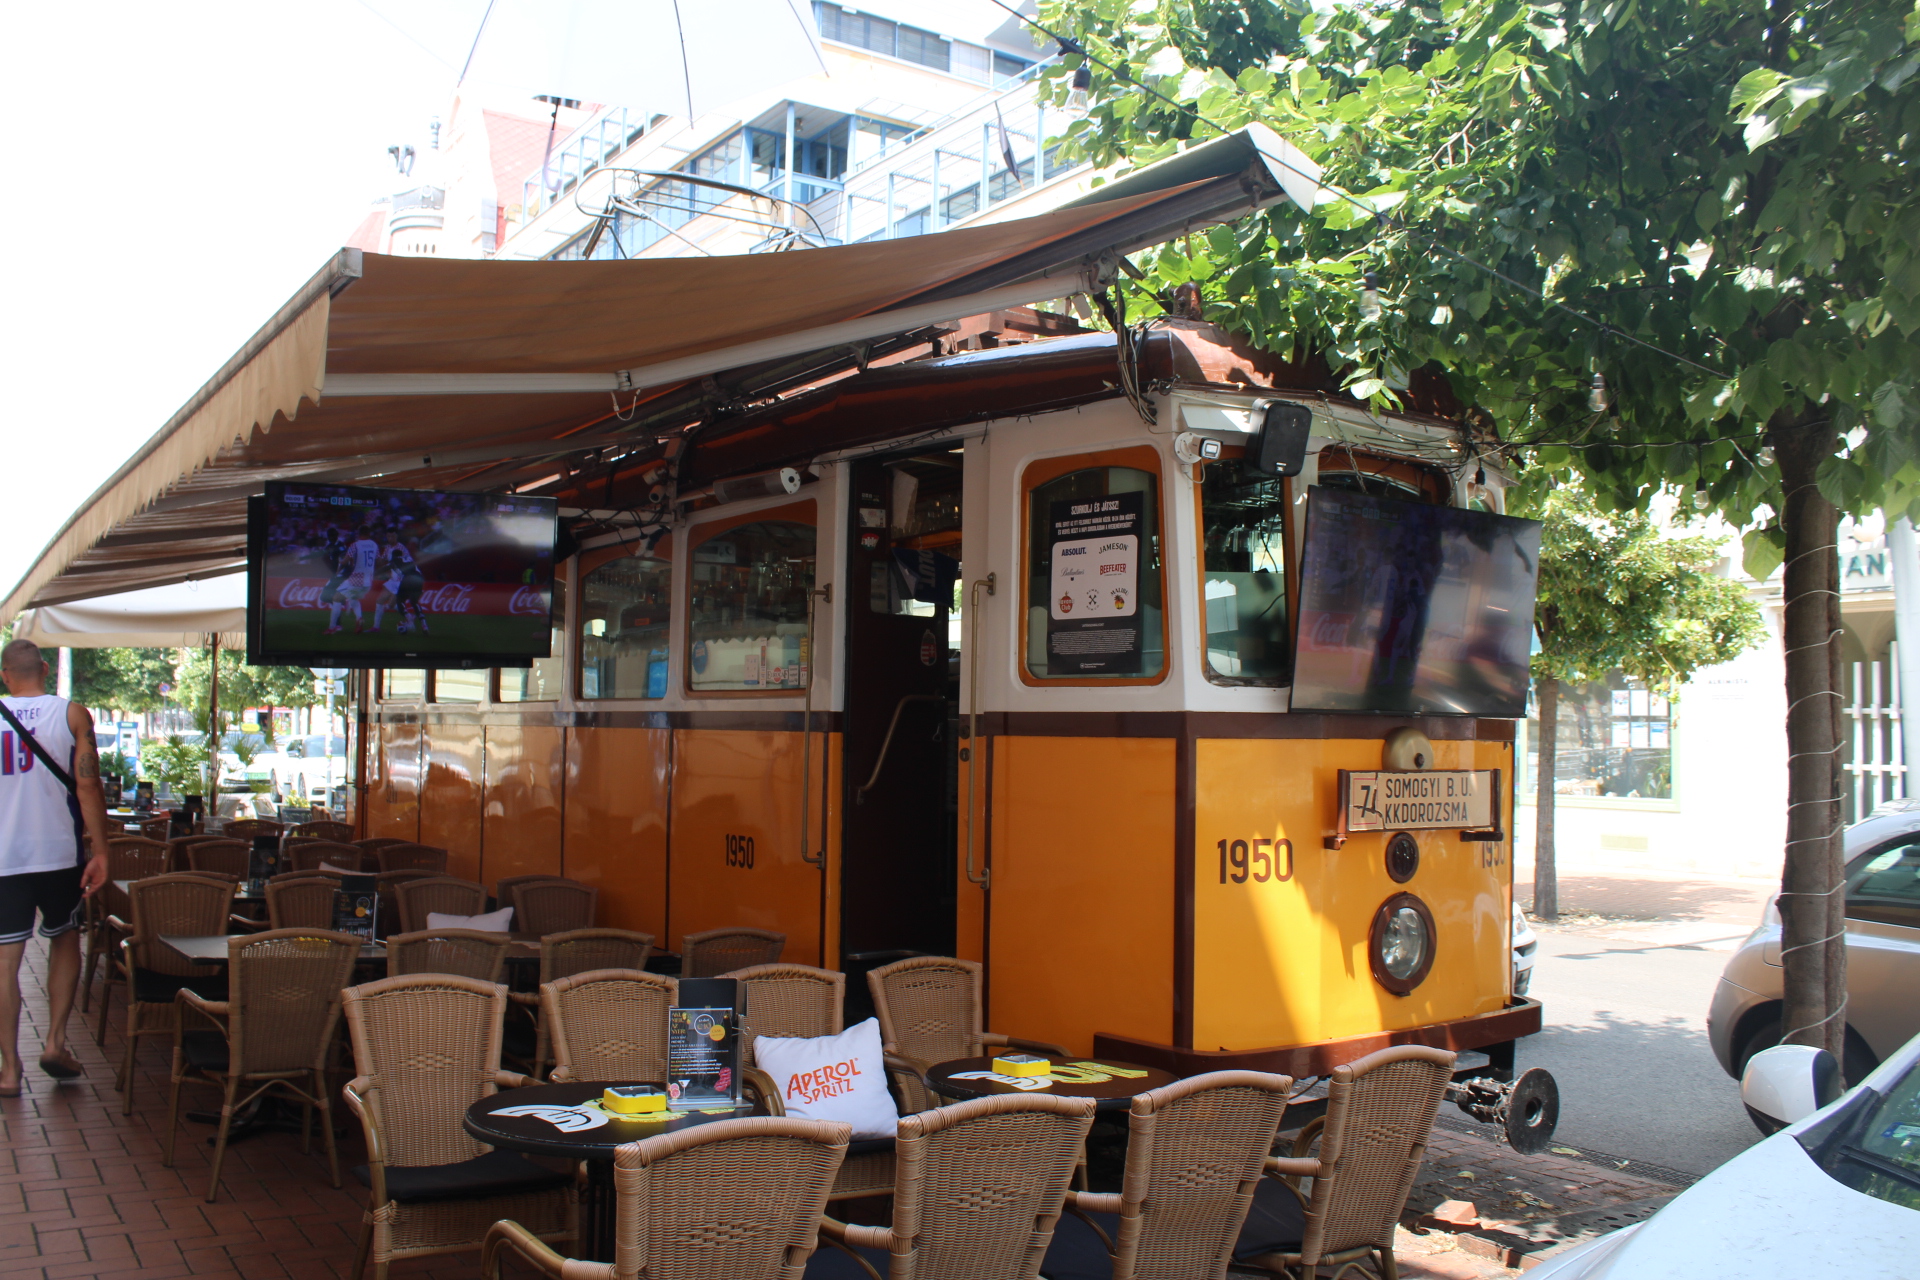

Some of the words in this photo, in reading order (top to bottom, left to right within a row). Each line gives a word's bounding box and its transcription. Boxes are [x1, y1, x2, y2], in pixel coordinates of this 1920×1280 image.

[1098, 542, 1128, 554] JAMESON
[1099, 563, 1127, 575] BEEFEATER
[1839, 553, 1884, 577] AN
[1385, 778, 1440, 798] SOMOGYI
[1447, 778, 1458, 797] B.
[1461, 777, 1472, 796] U.
[1385, 802, 1468, 824] KKDOROZSMA
[725, 833, 754, 869] 1950
[1217, 838, 1293, 884] 1950
[1482, 841, 1505, 869] 1950
[787, 1059, 862, 1100] APEROL
